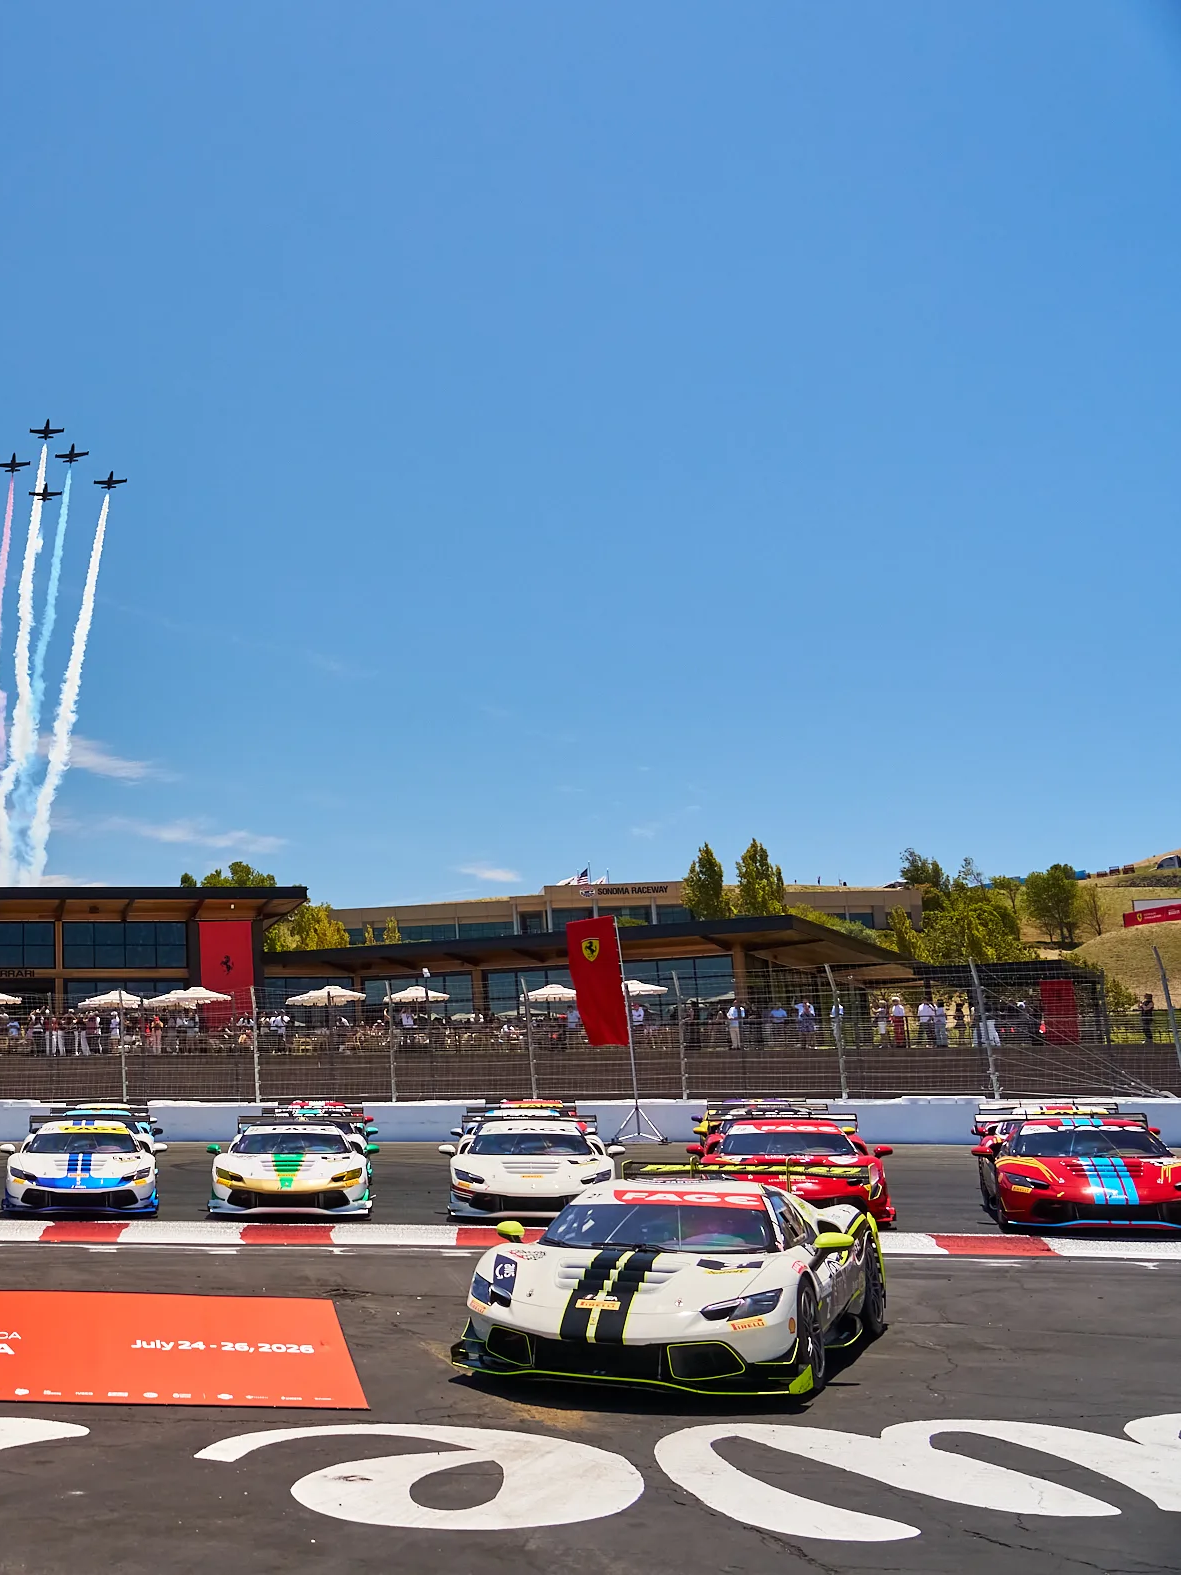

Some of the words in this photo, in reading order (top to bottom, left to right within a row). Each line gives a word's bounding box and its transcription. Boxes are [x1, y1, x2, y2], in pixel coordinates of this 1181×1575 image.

[597, 886, 630, 895] SONOMA
[631, 885, 669, 894] RACEWAY
[579, 1300, 616, 1309] PIRELLI
[731, 1318, 765, 1331] PIRELLI
[131, 1339, 175, 1351] July
[177, 1340, 206, 1350] 24
[221, 1341, 255, 1353] 26,
[257, 1343, 315, 1354] 2026
